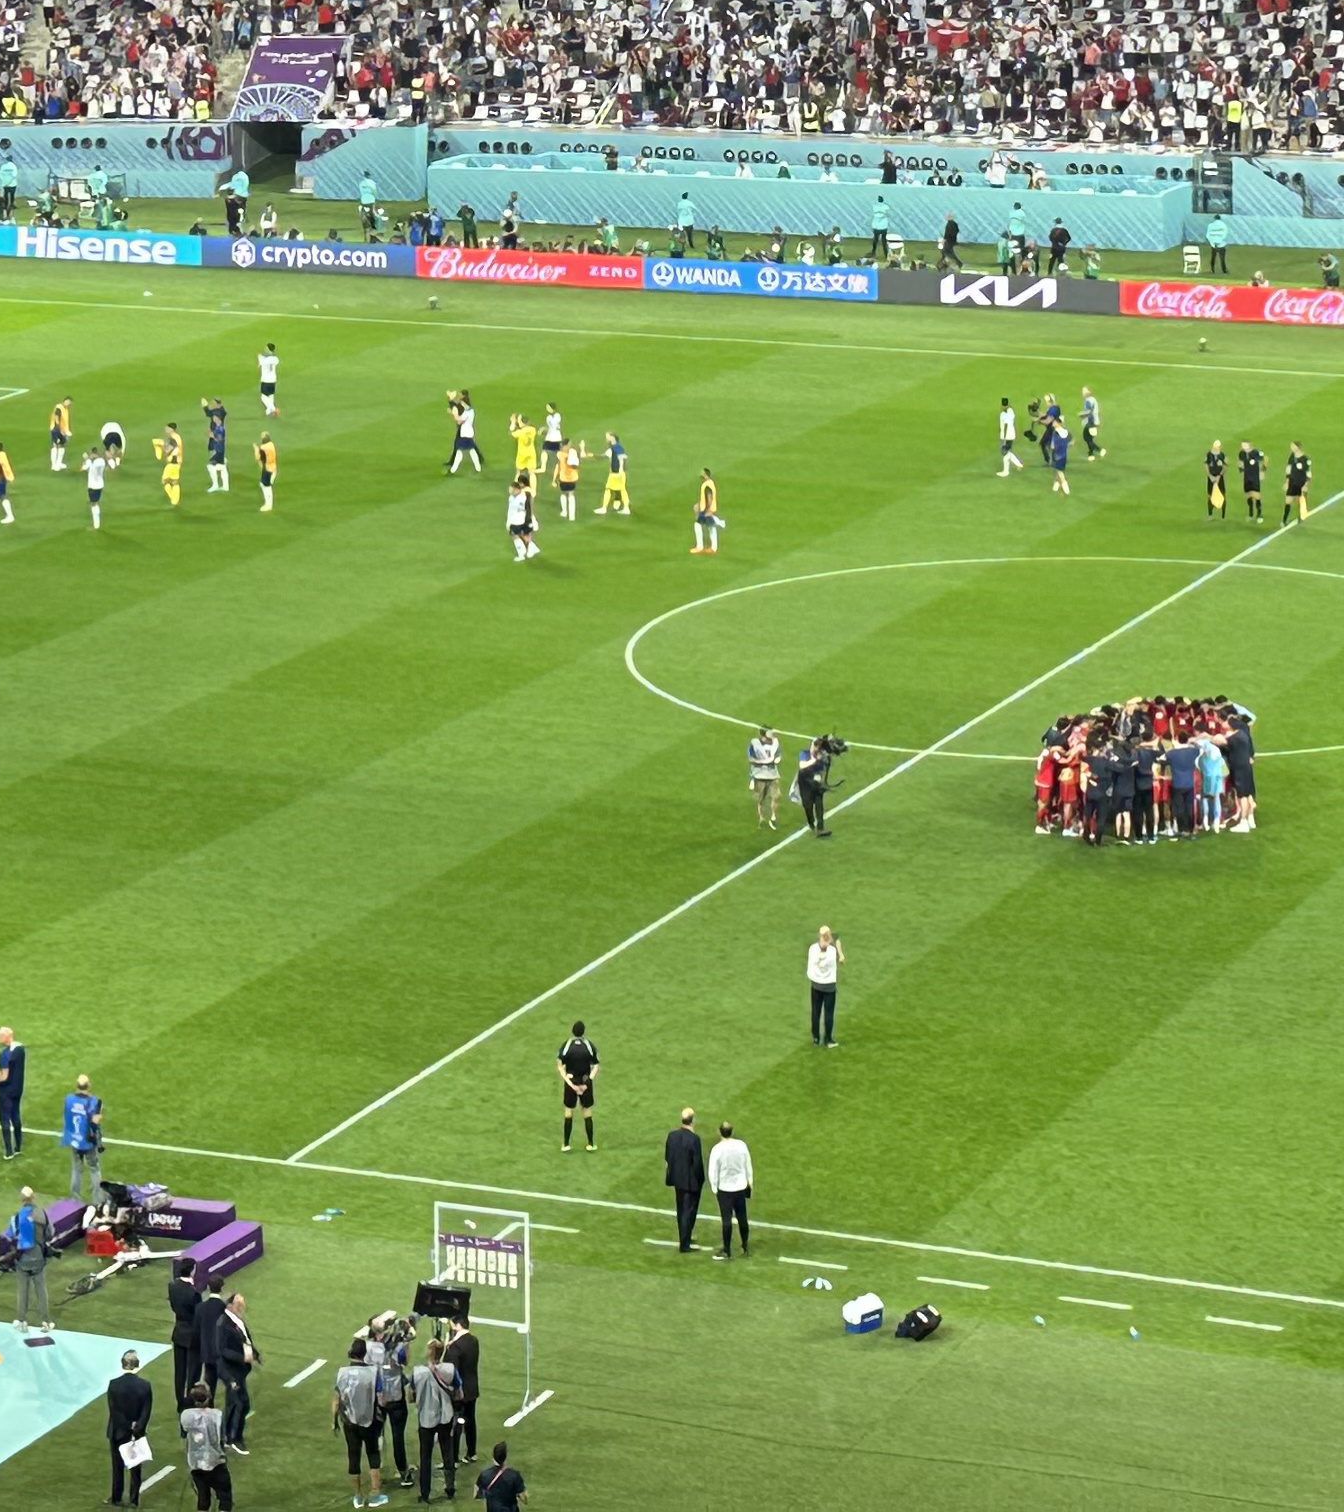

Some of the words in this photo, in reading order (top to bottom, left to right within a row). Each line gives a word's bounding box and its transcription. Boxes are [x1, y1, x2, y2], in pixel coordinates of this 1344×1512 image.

[16, 226, 177, 264] Hisense
[261, 244, 388, 270] crypto.com
[423, 247, 567, 282] Budweiser
[676, 264, 742, 287] WANDA
[939, 274, 1057, 308] KIA
